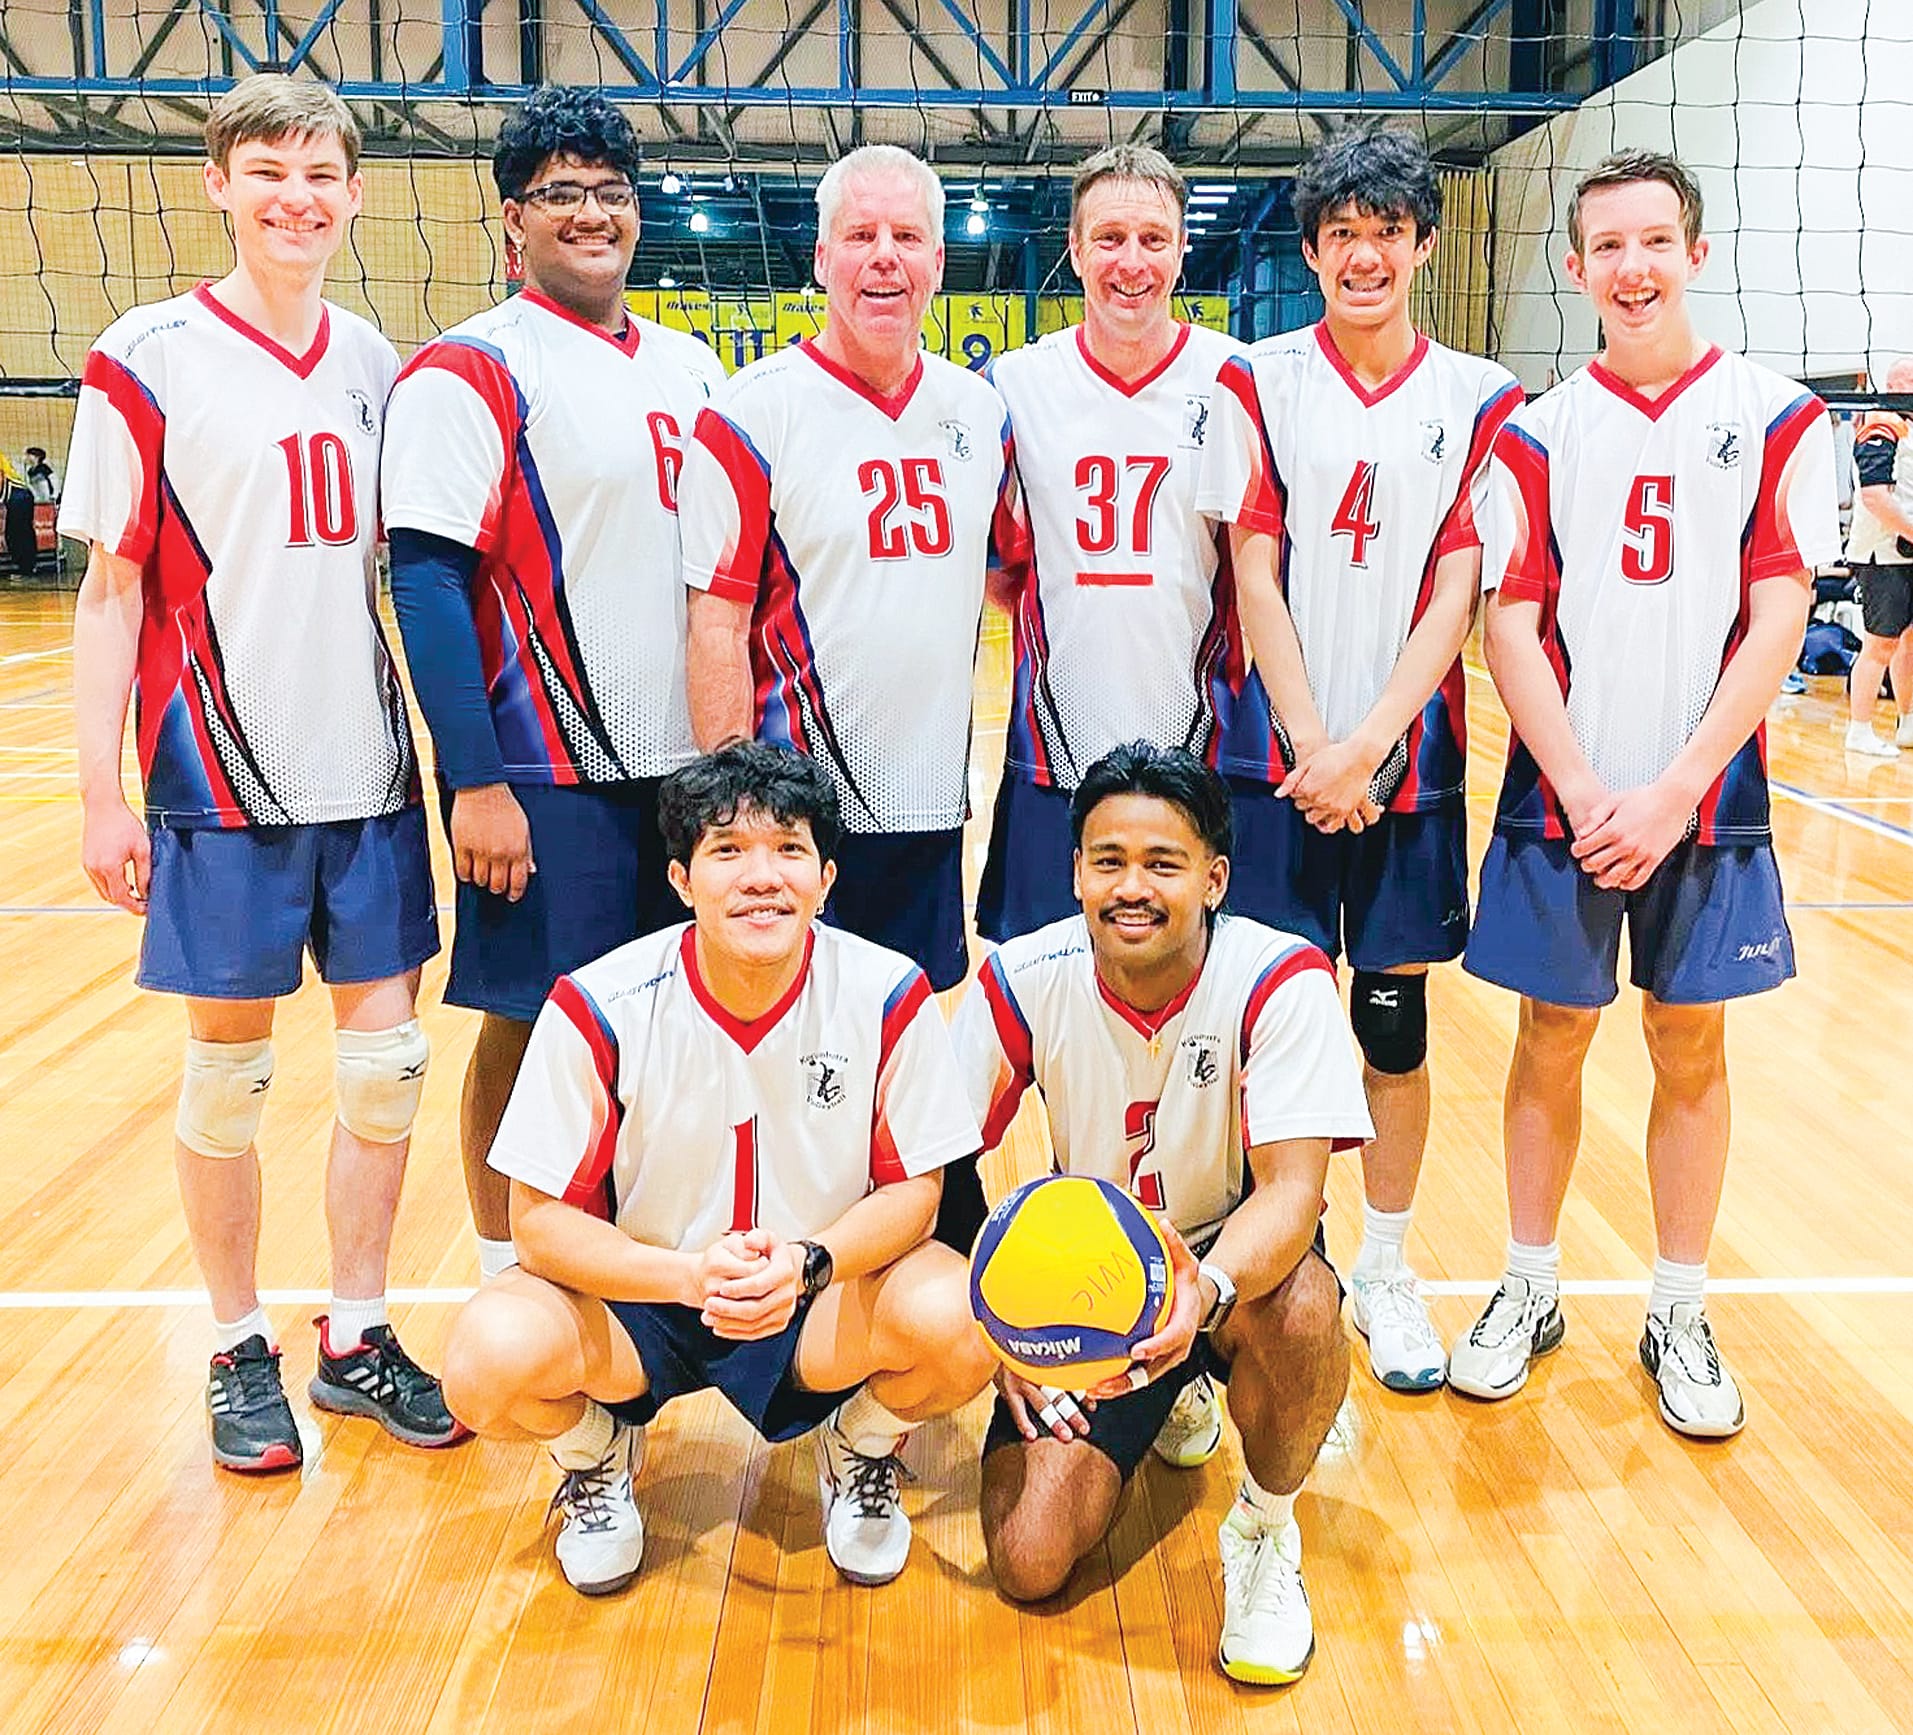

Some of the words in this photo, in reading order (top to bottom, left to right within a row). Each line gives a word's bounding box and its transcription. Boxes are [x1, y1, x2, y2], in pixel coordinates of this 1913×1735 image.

[1071, 91, 1094, 102] EXIT
[962, 334, 992, 372] 9
[275, 431, 359, 547] 10
[646, 411, 683, 515] 6
[857, 458, 955, 561] 25
[1074, 454, 1172, 556] 37
[1330, 460, 1380, 569] 4
[1619, 474, 1676, 586] 5
[729, 1113, 760, 1235] 1
[1124, 1100, 1166, 1210] 2
